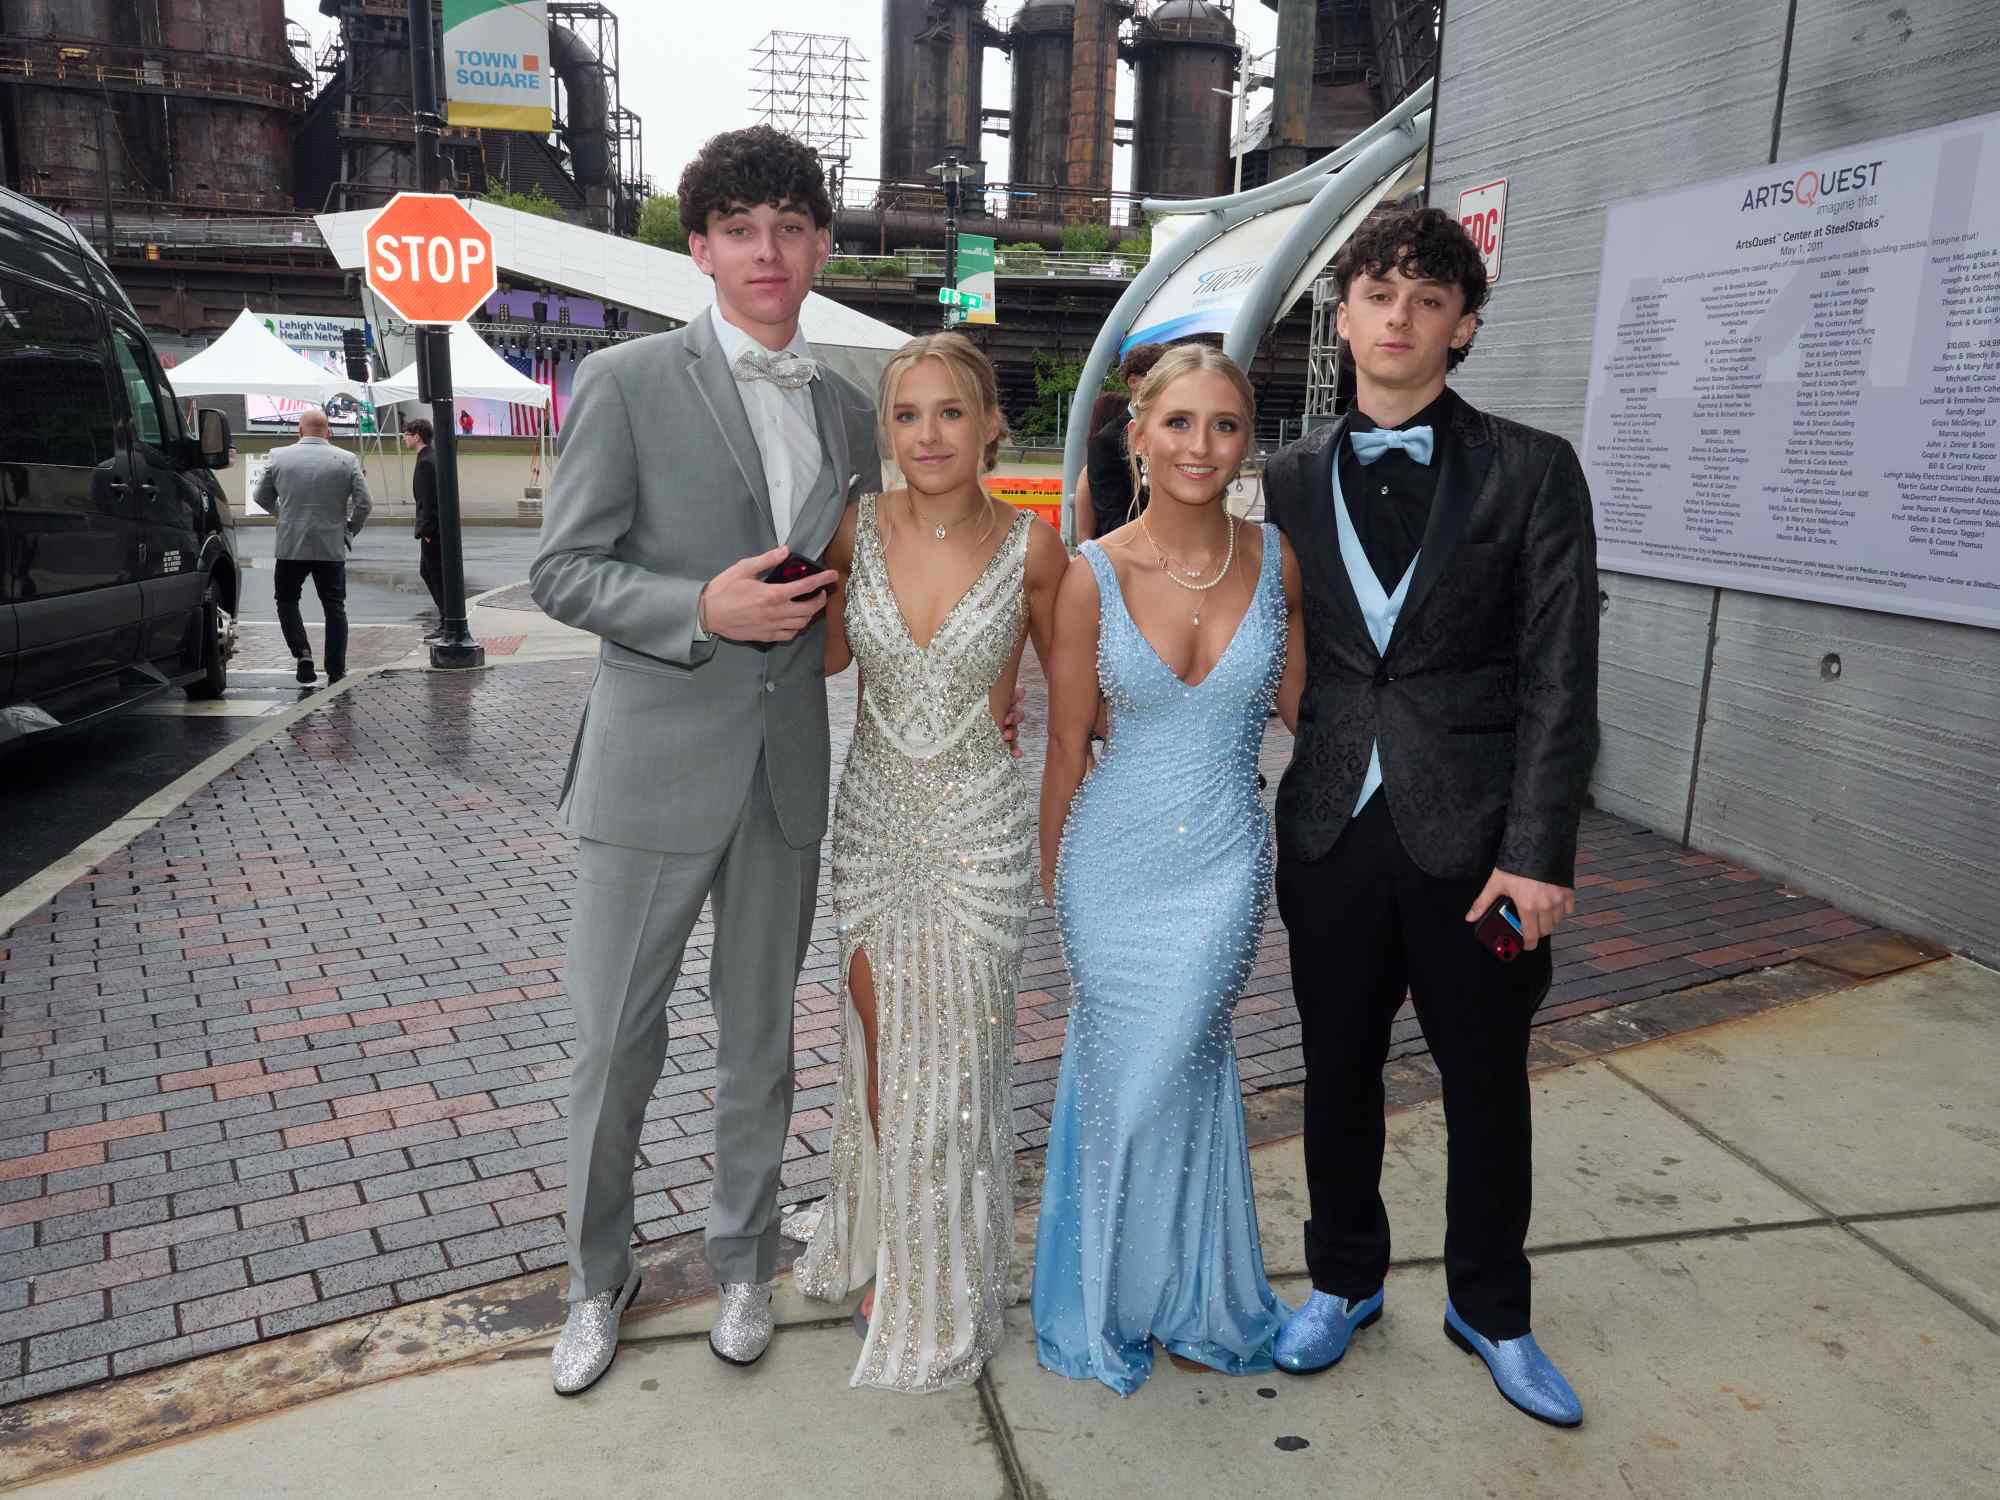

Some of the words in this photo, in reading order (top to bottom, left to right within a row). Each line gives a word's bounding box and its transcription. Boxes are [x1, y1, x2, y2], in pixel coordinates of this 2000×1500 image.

[455, 50, 518, 69] TOWN
[456, 70, 540, 89] SQUARE
[1817, 200, 1854, 216] imagine
[1857, 194, 1878, 208] that
[1783, 228, 1811, 243] Center
[1813, 228, 1823, 239] at
[1780, 245, 1797, 256] May
[1807, 241, 1823, 252] 2011
[375, 234, 487, 284] STOP
[279, 320, 314, 331] Lehigh
[315, 321, 345, 333] Valley
[280, 331, 312, 341] Health
